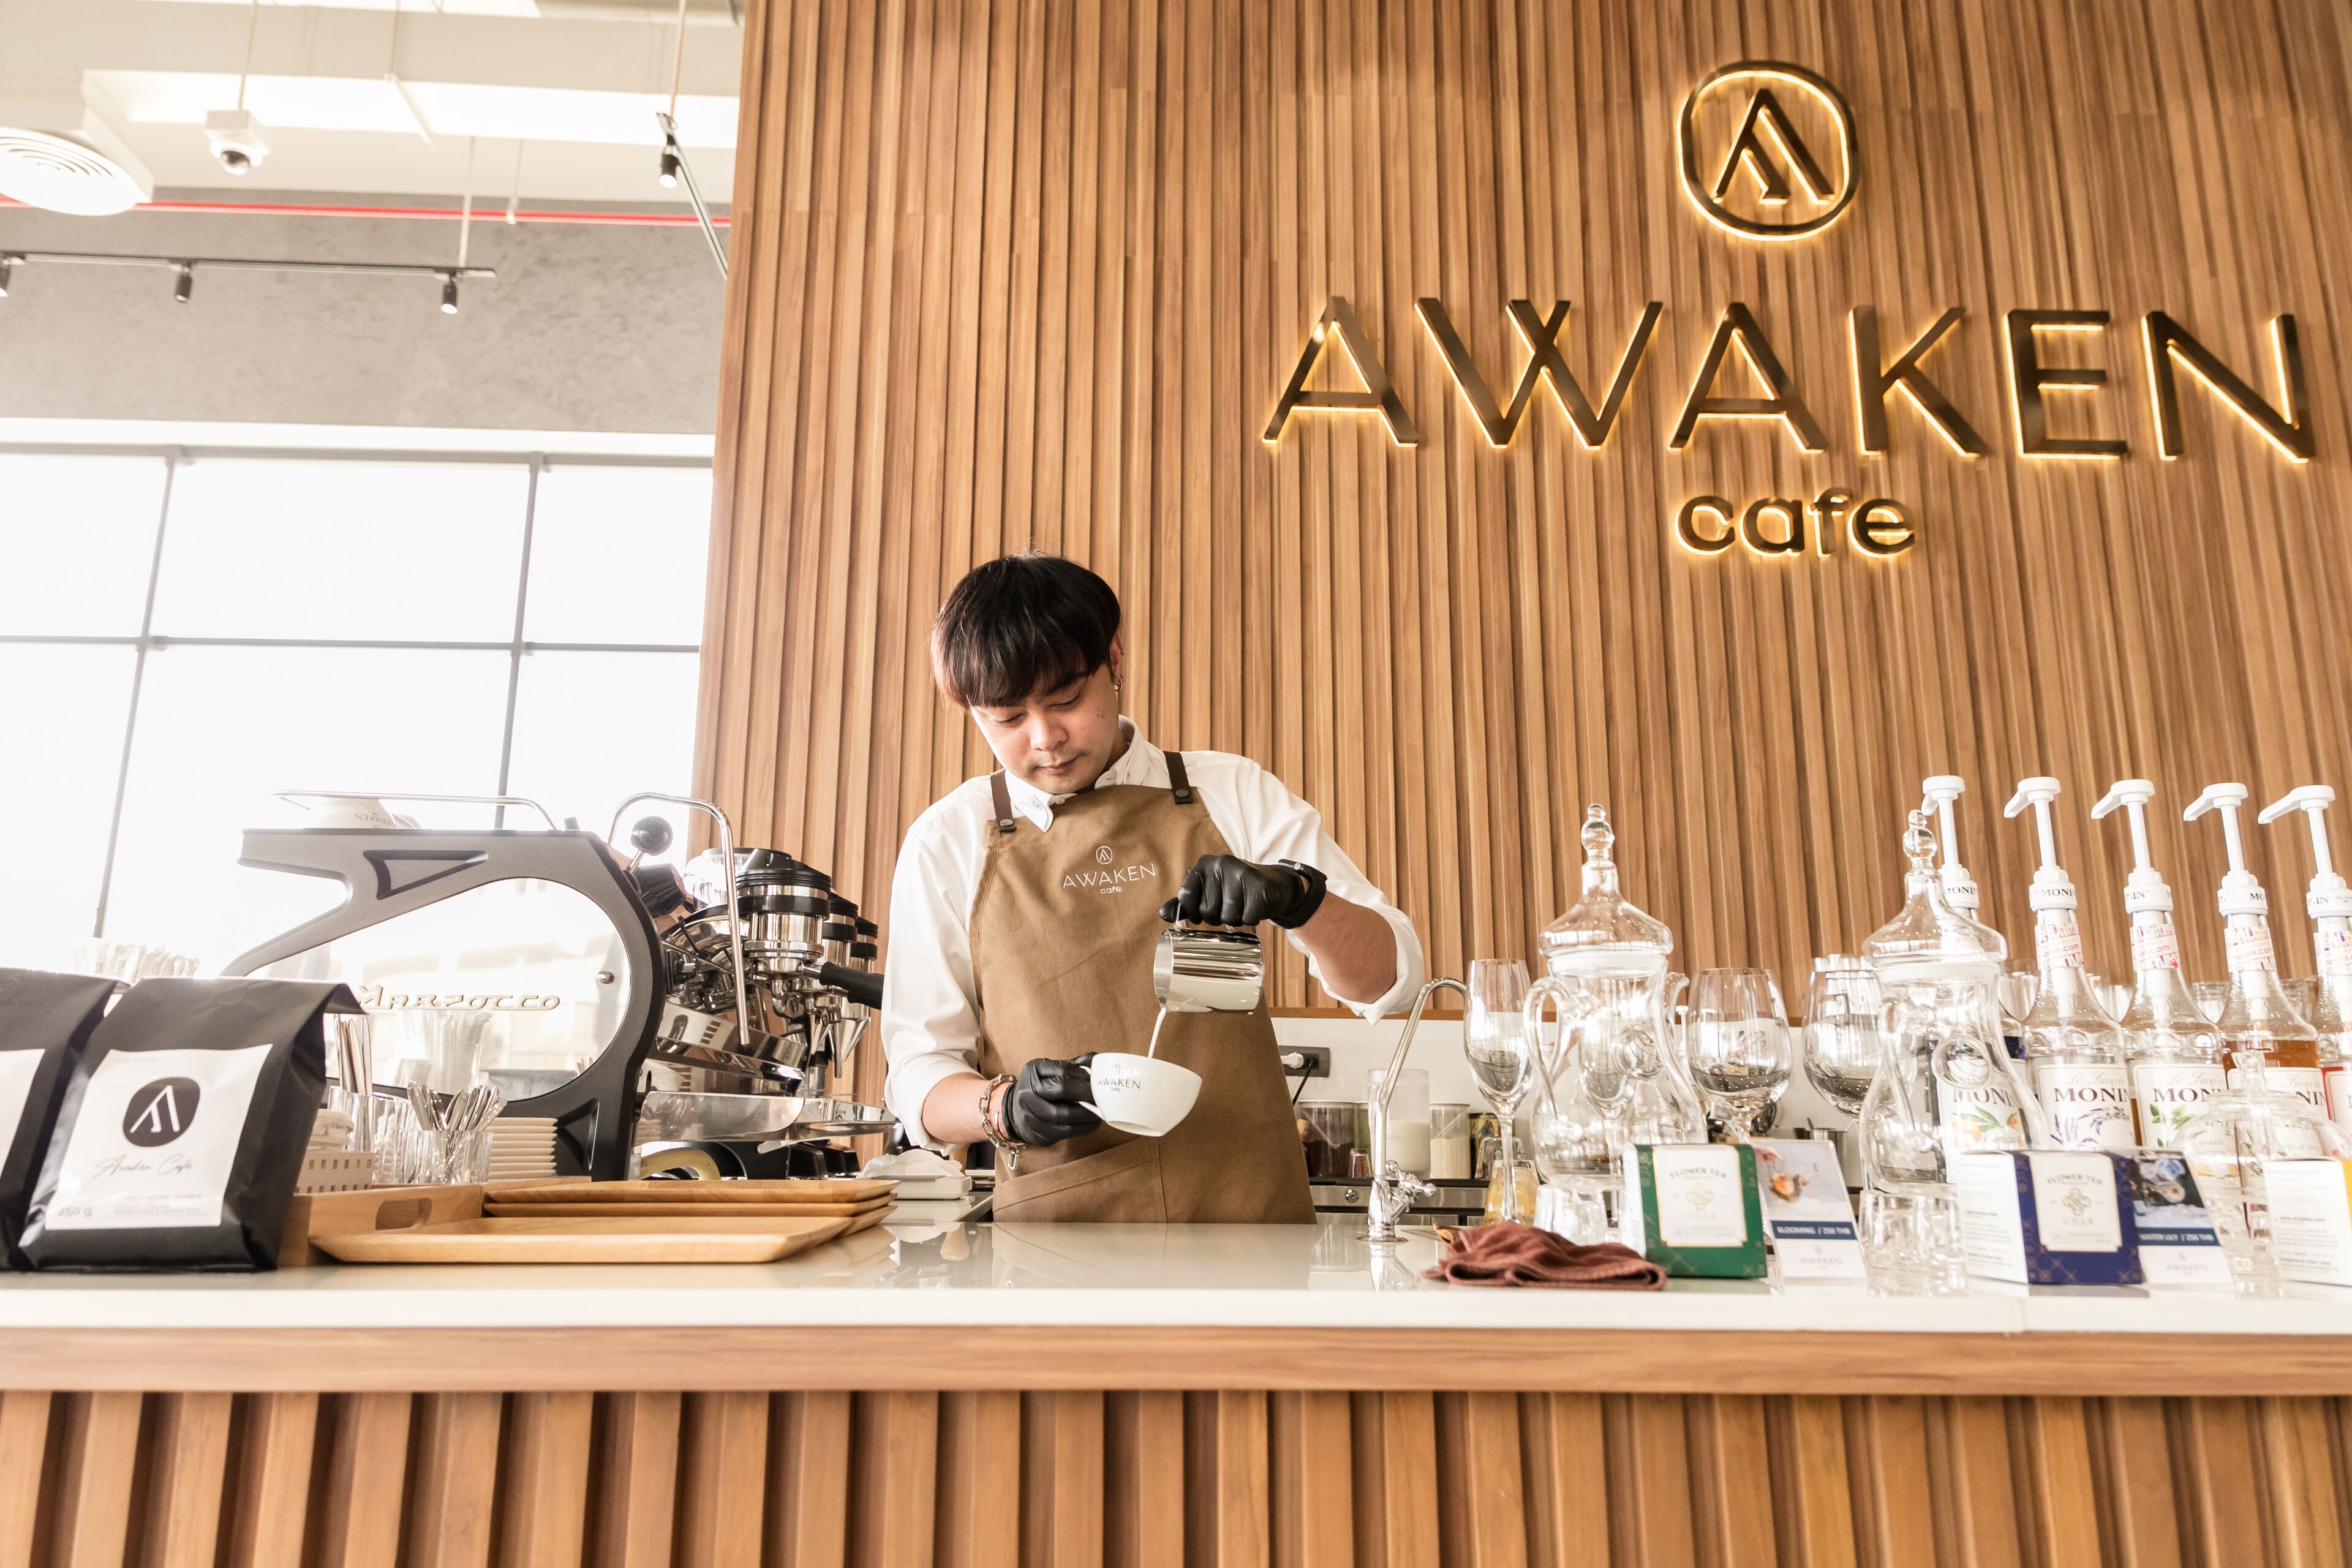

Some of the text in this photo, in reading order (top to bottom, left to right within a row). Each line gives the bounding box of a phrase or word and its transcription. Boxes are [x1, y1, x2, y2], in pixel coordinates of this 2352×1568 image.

[1262, 296, 2317, 464] AWAKEN
[1674, 487, 1915, 558] cafe
[1063, 862, 1156, 888] AWAKEN
[1100, 886, 1121, 894] cafe
[1098, 1077, 1141, 1090] AWAKEN
[1953, 1087, 2016, 1107] MONI
[1670, 1166, 1706, 1179] FLOWER
